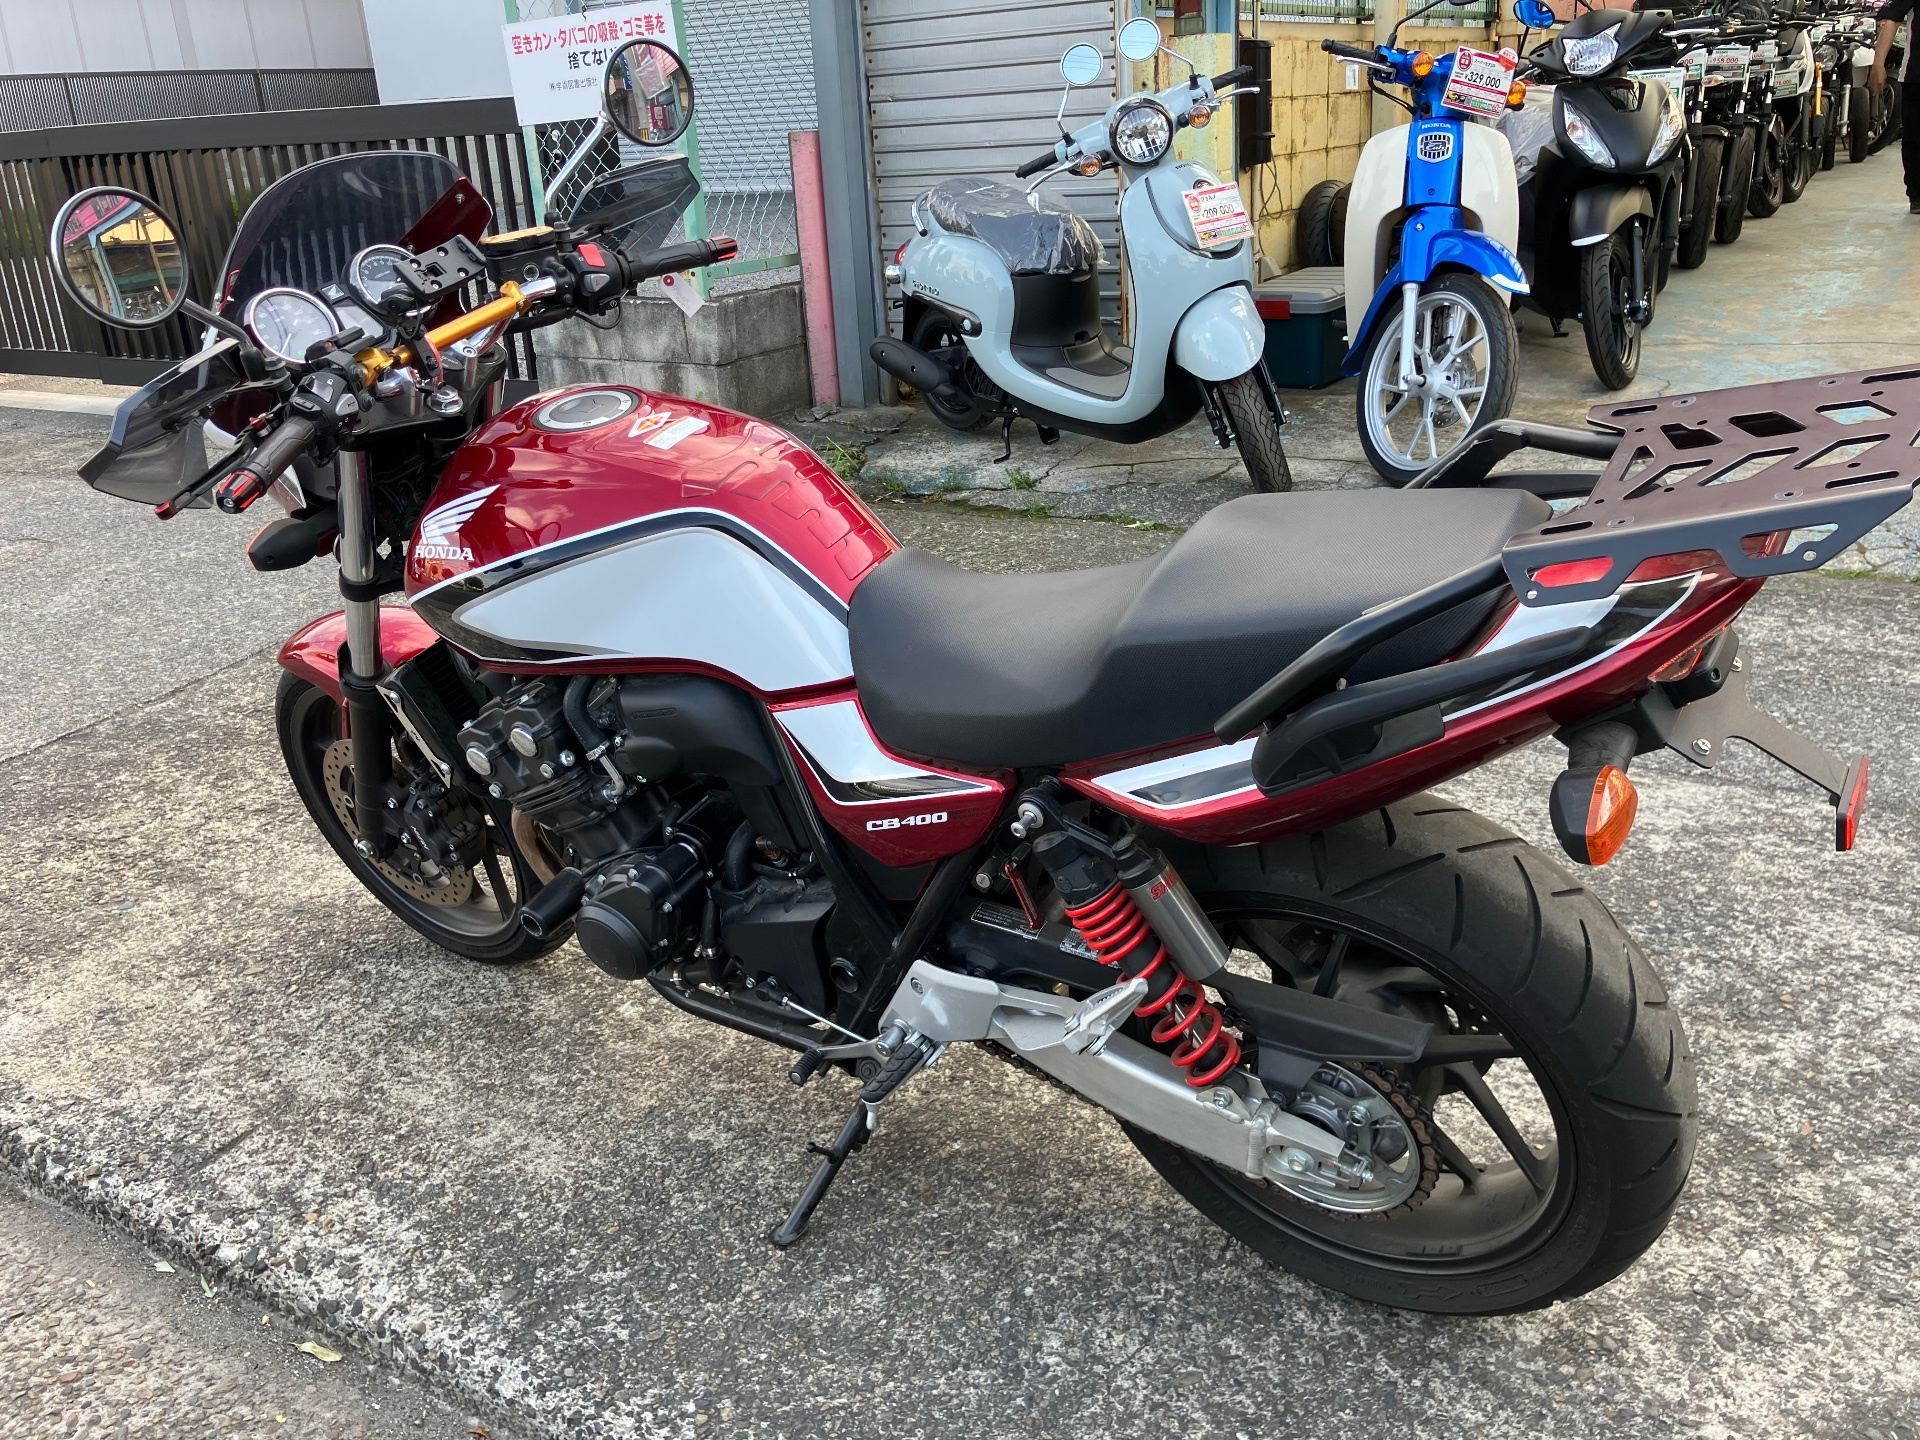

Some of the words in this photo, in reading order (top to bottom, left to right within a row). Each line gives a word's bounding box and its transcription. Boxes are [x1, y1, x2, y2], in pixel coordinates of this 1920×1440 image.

[511, 13, 666, 55] 空きカン・タバコの吸殻・ゴミ等を
[568, 47, 618, 70] 捨てない
[415, 545, 474, 561] HONDA
[866, 811, 948, 831] CB400
